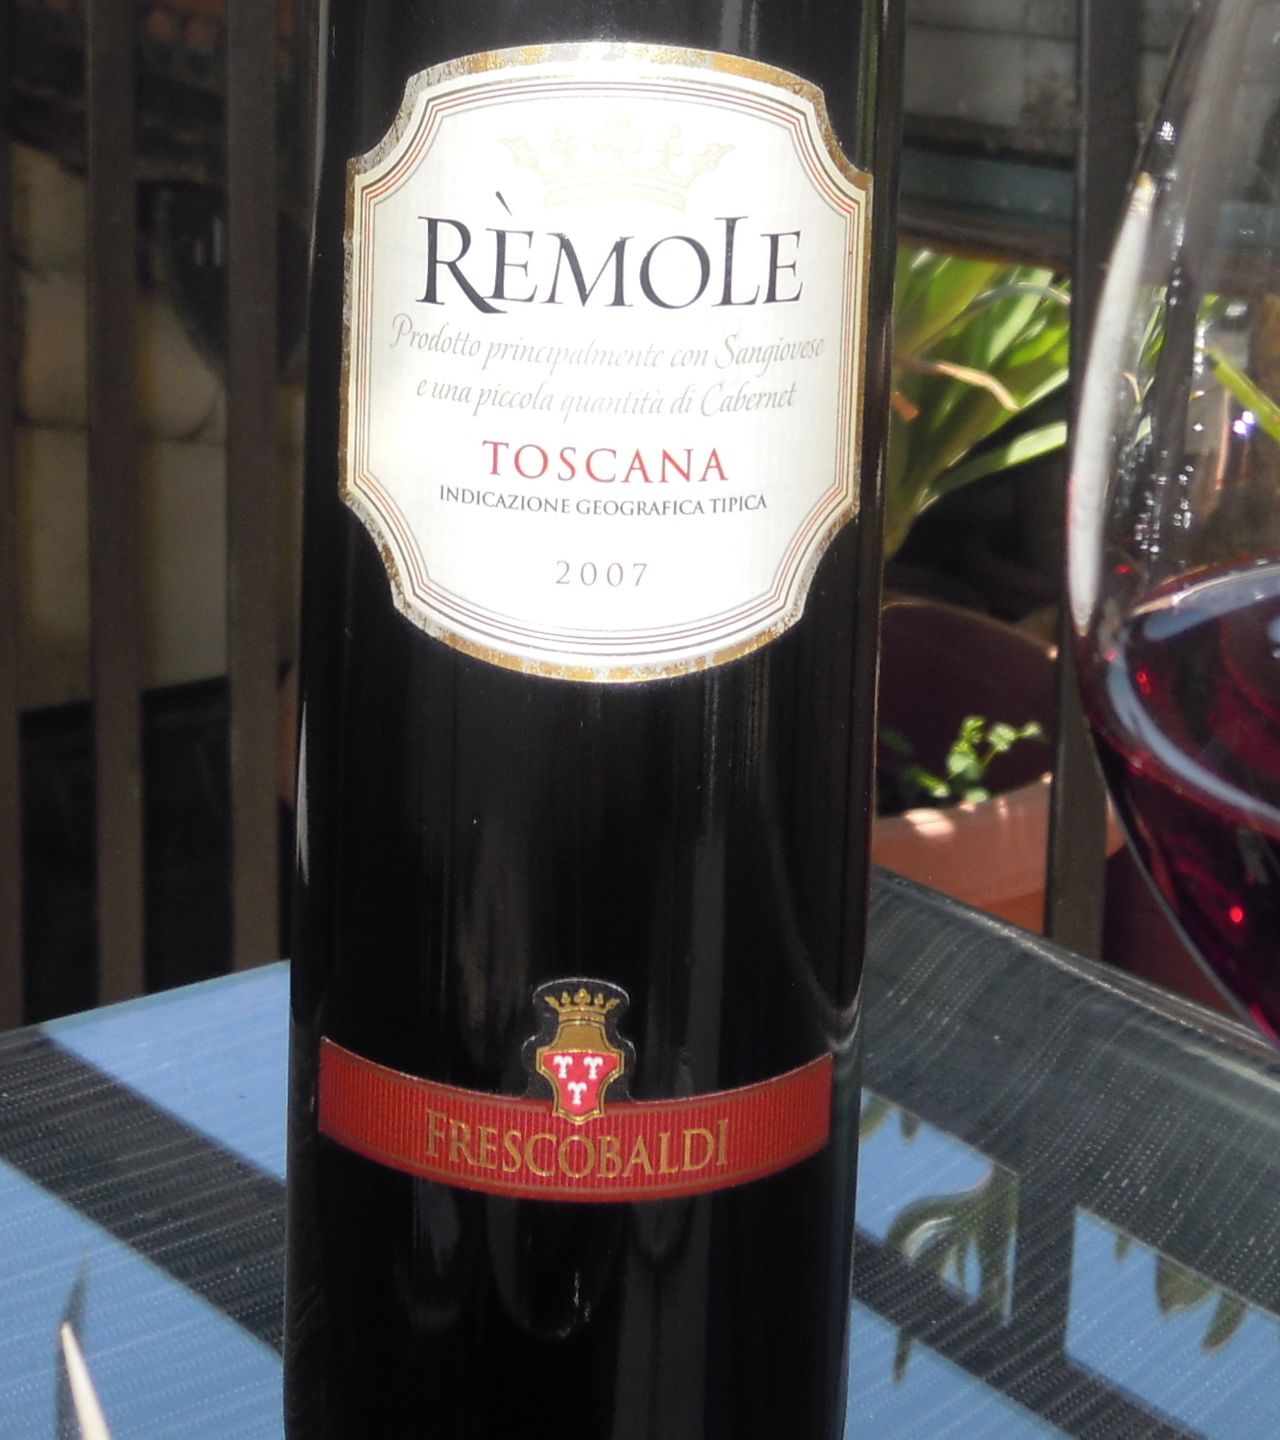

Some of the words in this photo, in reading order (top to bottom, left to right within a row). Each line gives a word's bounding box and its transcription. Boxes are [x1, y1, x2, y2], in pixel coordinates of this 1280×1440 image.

[415, 191, 804, 315] RÈMOLE
[389, 313, 482, 358] Prodotto
[482, 334, 665, 375] principalmente
[669, 344, 710, 367] con
[714, 333, 825, 378] Sangiovese
[416, 378, 428, 397] e
[431, 385, 474, 406] una
[472, 385, 555, 417] piccola
[559, 389, 663, 424] quantità
[668, 385, 695, 415] di
[700, 379, 798, 418] Cabernet
[482, 439, 729, 484] TOSCANA
[438, 484, 571, 515] INDICAZIONE
[575, 499, 705, 517] GEOGRAFICA
[709, 494, 768, 515] TIPICA
[555, 560, 647, 588] 2007
[425, 1109, 730, 1178] FRESCOBALDI
